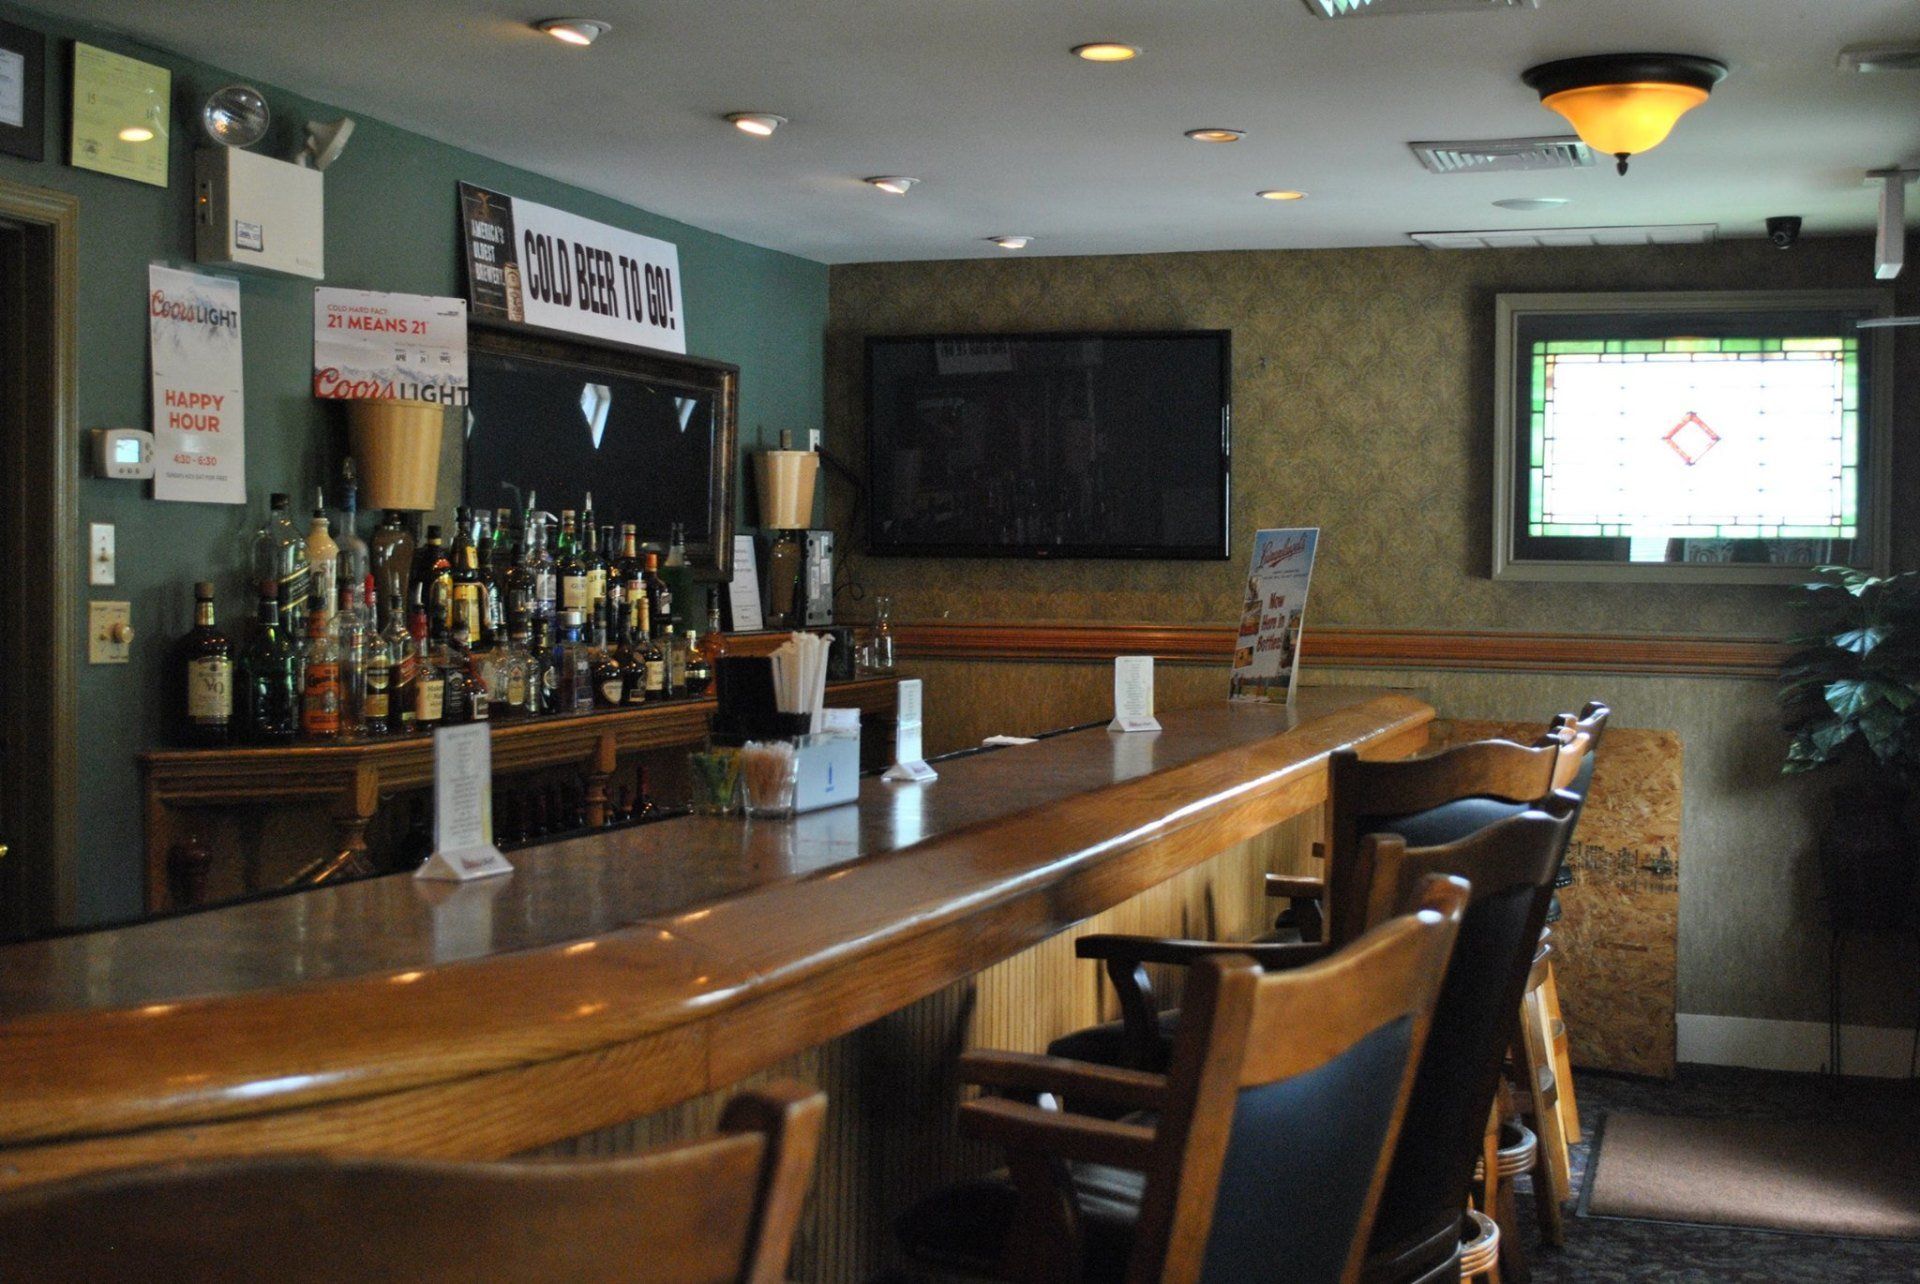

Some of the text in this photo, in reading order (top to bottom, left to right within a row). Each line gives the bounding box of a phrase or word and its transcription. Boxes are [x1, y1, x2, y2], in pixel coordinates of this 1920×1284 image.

[471, 219, 505, 245] AMERICA'S
[524, 229, 675, 330] COLD BEER TO GO!
[151, 290, 237, 329] Coors LIGHT
[326, 303, 347, 312] COLD
[349, 305, 369, 314] HARD
[327, 314, 427, 334] 21 MEANS 21
[313, 367, 469, 406] Coors LIGHT
[165, 389, 225, 411] HAPPY
[169, 411, 220, 433] HOUR
[174, 454, 191, 464] 4:30
[198, 456, 217, 466] 6:30
[1269, 592, 1285, 609] Now
